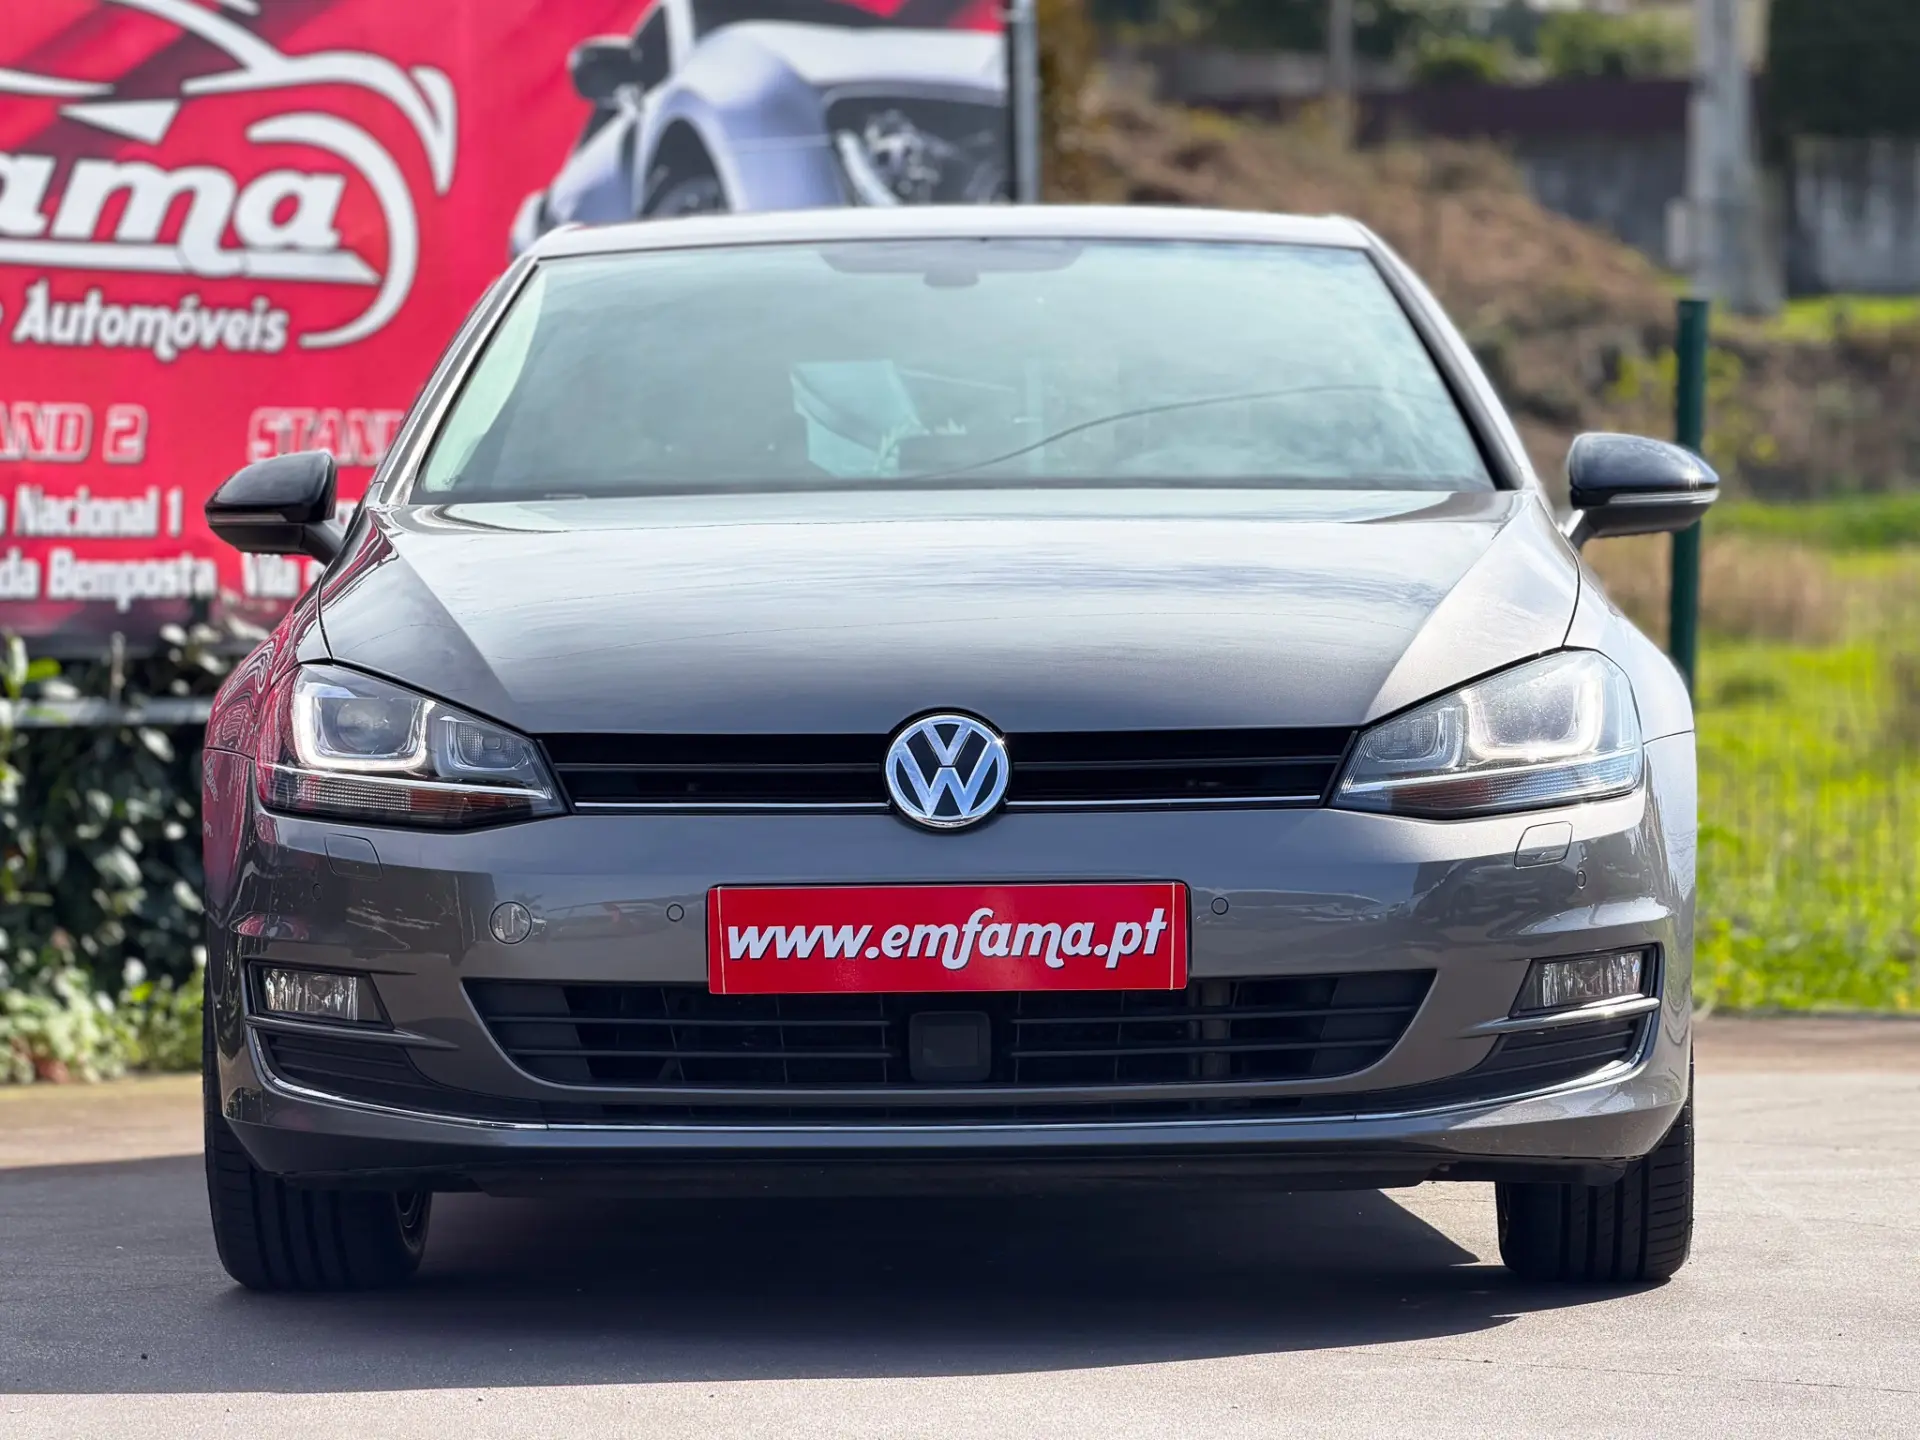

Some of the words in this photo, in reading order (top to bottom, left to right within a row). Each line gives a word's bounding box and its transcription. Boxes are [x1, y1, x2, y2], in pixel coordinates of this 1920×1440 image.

[12, 278, 289, 362] Automóveis
[103, 404, 148, 464] 2
[14, 485, 159, 537] Nacional
[167, 487, 182, 537] 1
[47, 549, 217, 612] Bemposta
[727, 907, 1168, 970] www.emfama.pt
